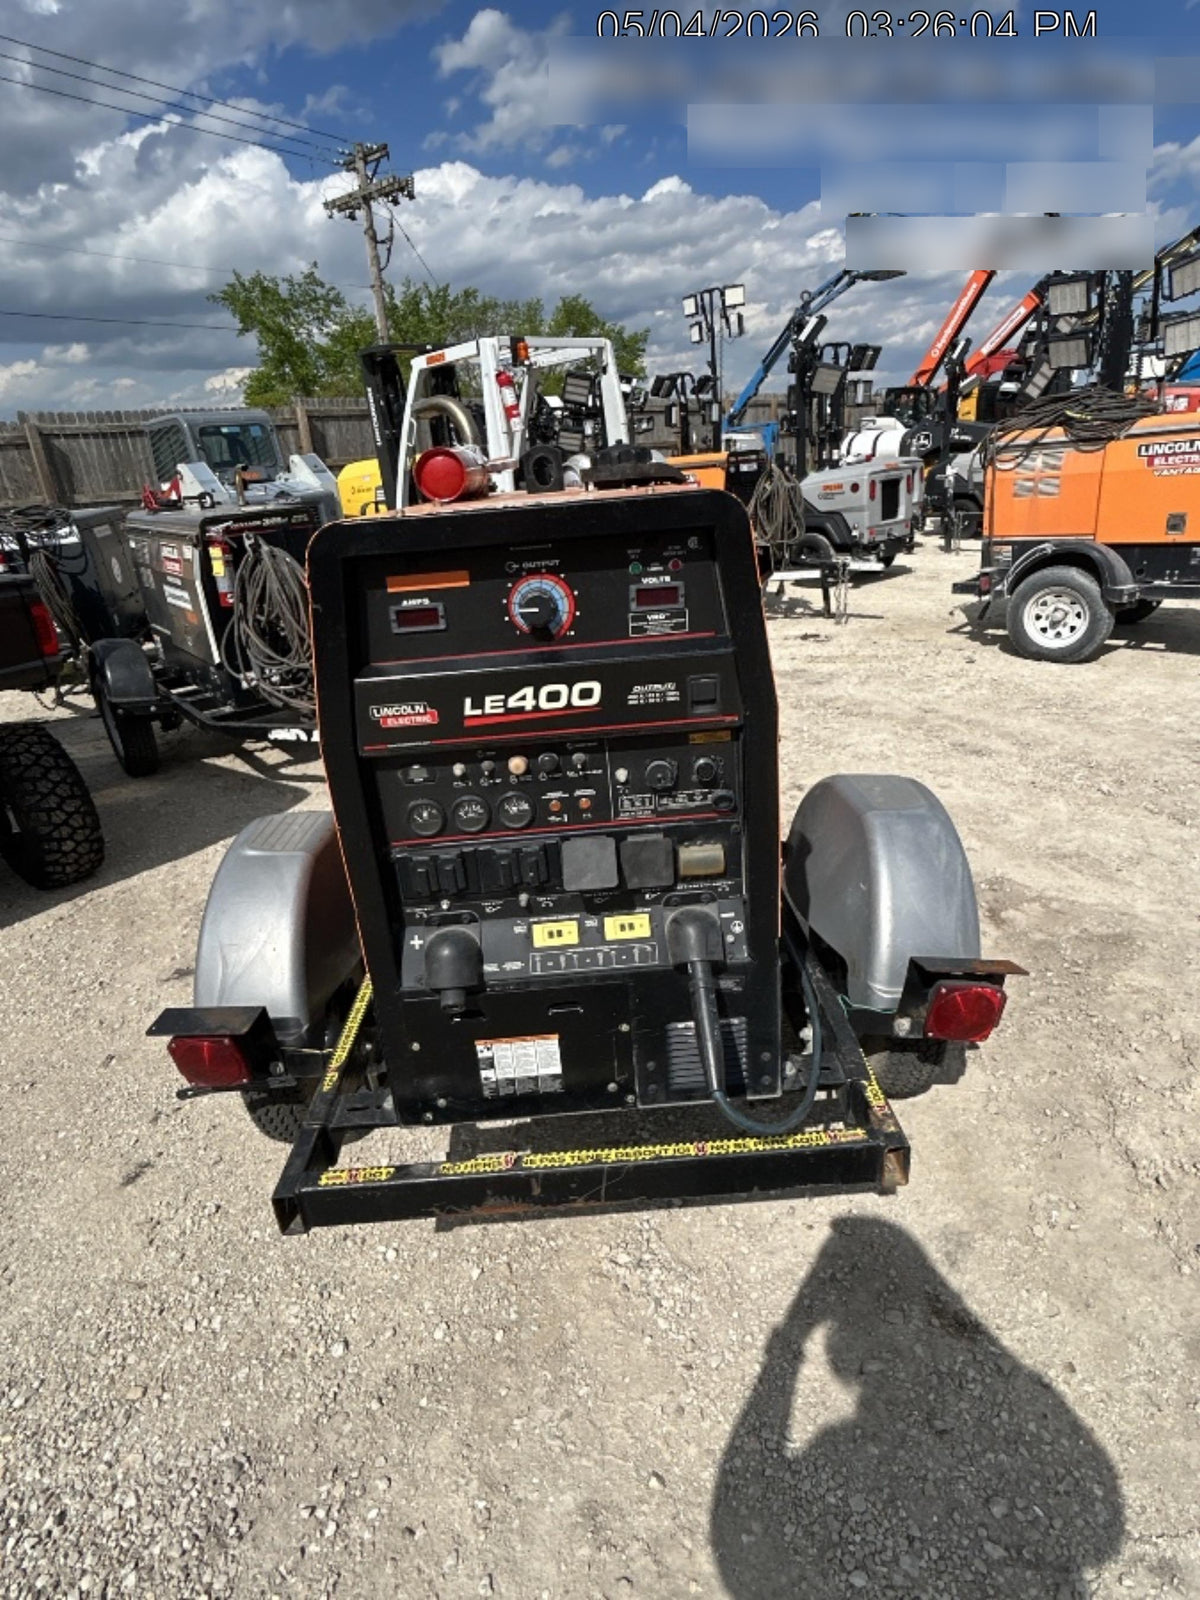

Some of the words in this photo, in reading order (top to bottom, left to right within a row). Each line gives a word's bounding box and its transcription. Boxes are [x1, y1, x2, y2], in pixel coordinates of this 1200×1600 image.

[522, 559, 560, 568] OUTPUT
[641, 575, 671, 584] VOLTS
[401, 597, 430, 606] AMPS
[463, 680, 602, 716] LE400
[373, 704, 425, 718] LINCOLN
[387, 715, 432, 726] ELECTRIC
